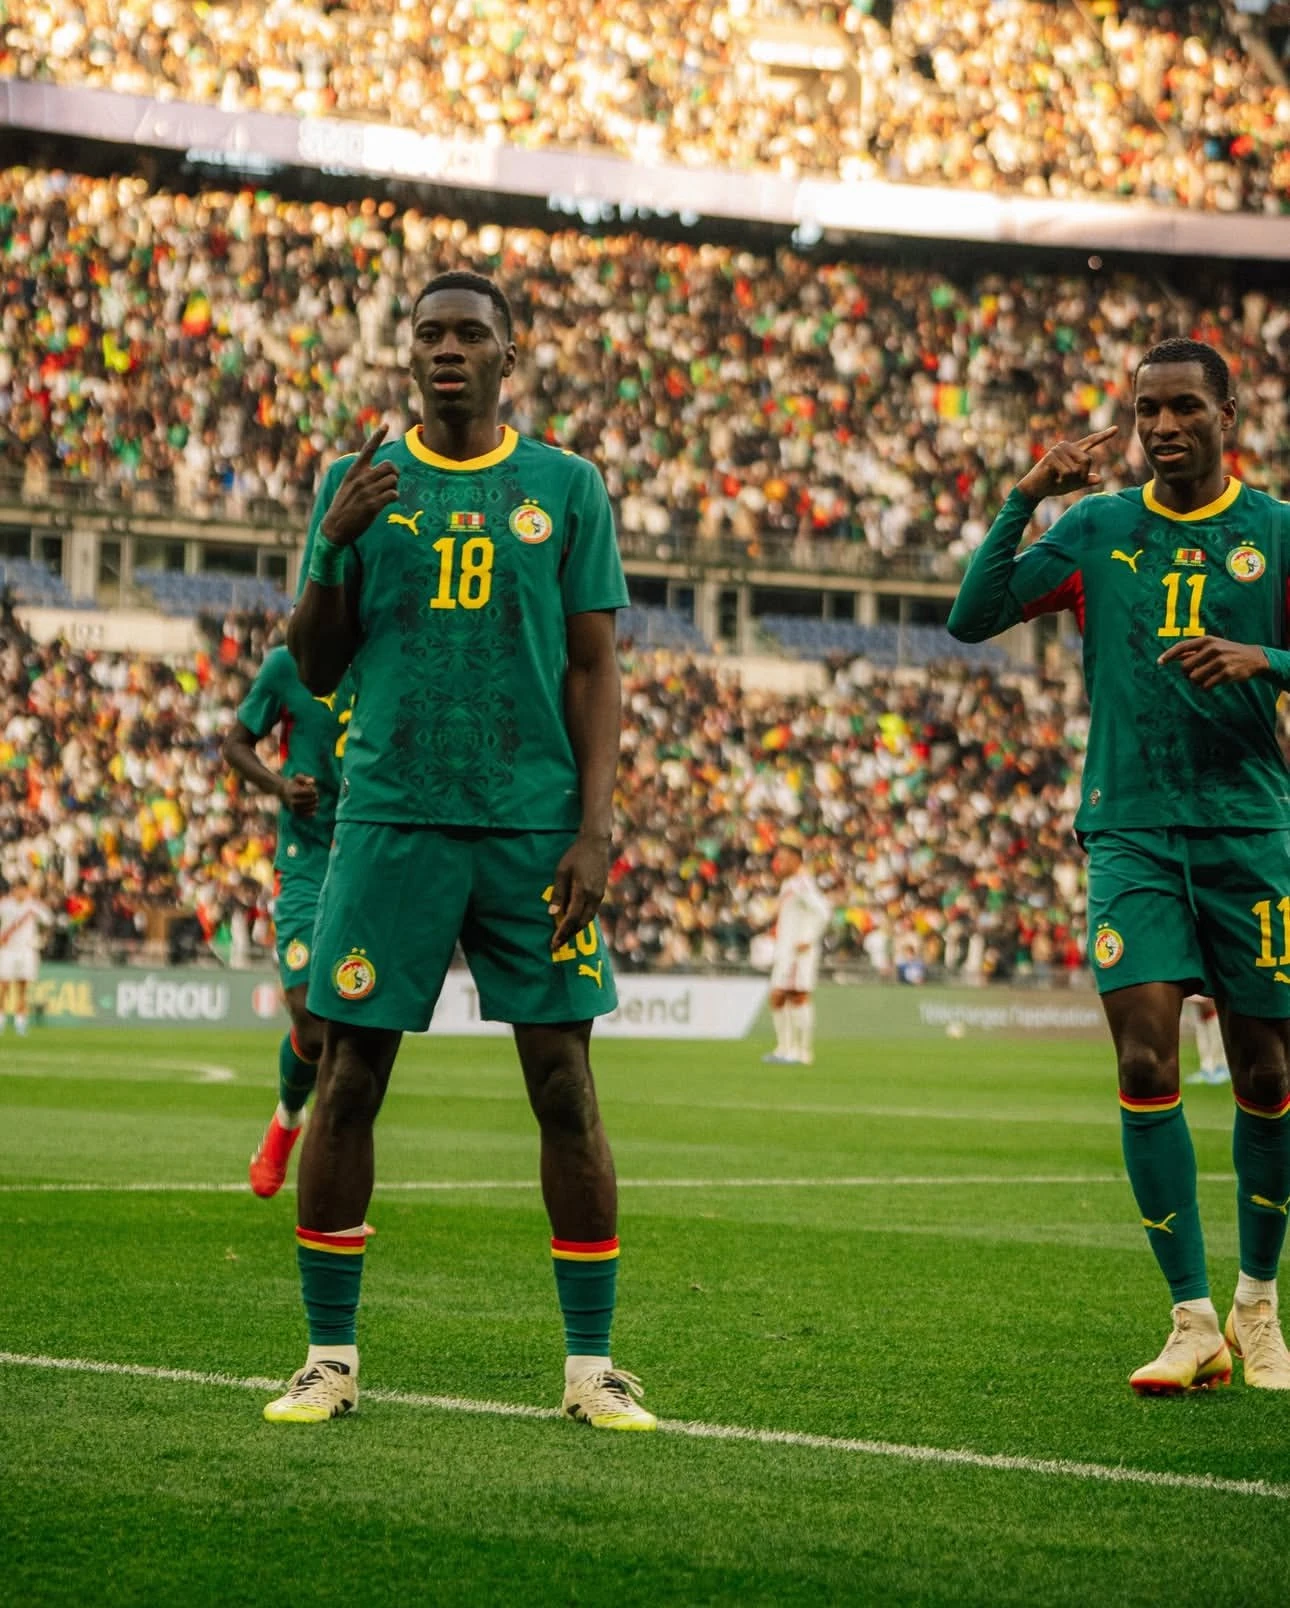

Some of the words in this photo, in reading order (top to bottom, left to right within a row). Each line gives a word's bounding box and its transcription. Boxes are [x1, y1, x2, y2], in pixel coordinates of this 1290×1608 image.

[430, 537, 494, 609] 18
[1157, 572, 1208, 637] 11
[1251, 896, 1290, 968] 11
[116, 975, 229, 1019] PÉROU
